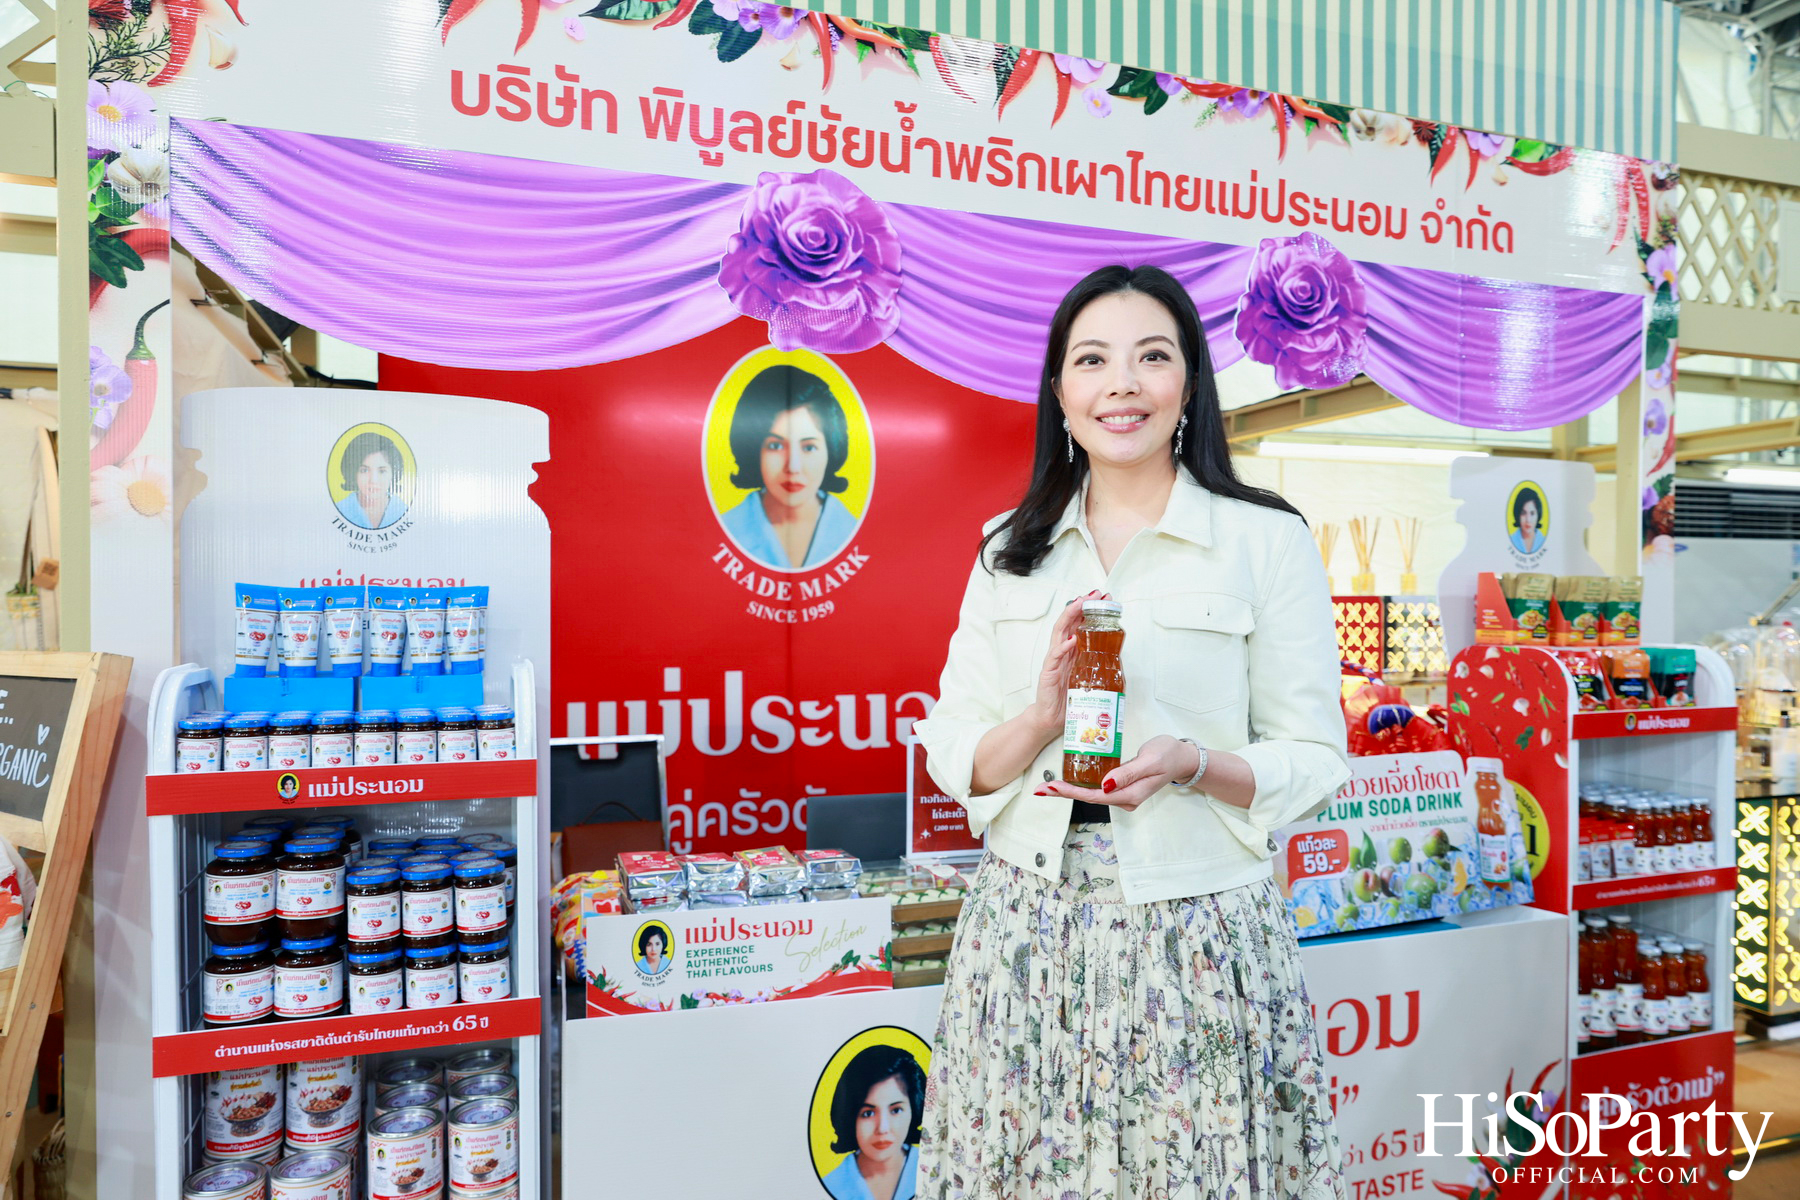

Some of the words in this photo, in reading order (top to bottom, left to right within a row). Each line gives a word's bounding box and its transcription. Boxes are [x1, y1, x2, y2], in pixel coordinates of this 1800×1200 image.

[449, 63, 617, 134] บริษัท
[638, 86, 1407, 241] พิบูลย์ชัยน้ำพริกเผาไทยแม่ประนอม
[1420, 198, 1515, 253] จำกัด
[332, 515, 373, 543] TRADE
[377, 517, 414, 542] MARK
[347, 541, 377, 554] SINCE
[380, 542, 398, 553] 1959
[712, 543, 792, 601] TRADE
[799, 545, 870, 601] MARK
[746, 601, 798, 623] SINCE
[801, 600, 835, 622] 1959
[308, 776, 424, 798] แม่ประนอม
[1368, 797, 1412, 817] SODA
[1416, 792, 1463, 812] DRINK
[1297, 835, 1338, 853] แก้วละ
[1304, 852, 1341, 874] 59.-
[685, 917, 813, 944] แม่ประนอม
[686, 945, 755, 958] EXPERIENCE
[785, 919, 867, 973] Selection
[633, 969, 654, 982] TRADE
[655, 967, 674, 981] MARK
[686, 956, 748, 968] AUTHENTIC
[686, 970, 712, 979] THAI
[715, 964, 774, 977] FLAVOURS
[215, 1021, 449, 1058] ตำนานแห่งรสชาติต้นตำรับไทยแท้มากว่า
[452, 1015, 477, 1031] 65
[480, 1016, 489, 1029] ปี
[1311, 991, 1419, 1057] อม
[1371, 1129, 1407, 1161] 65
[1352, 1169, 1424, 1200] TASTE
